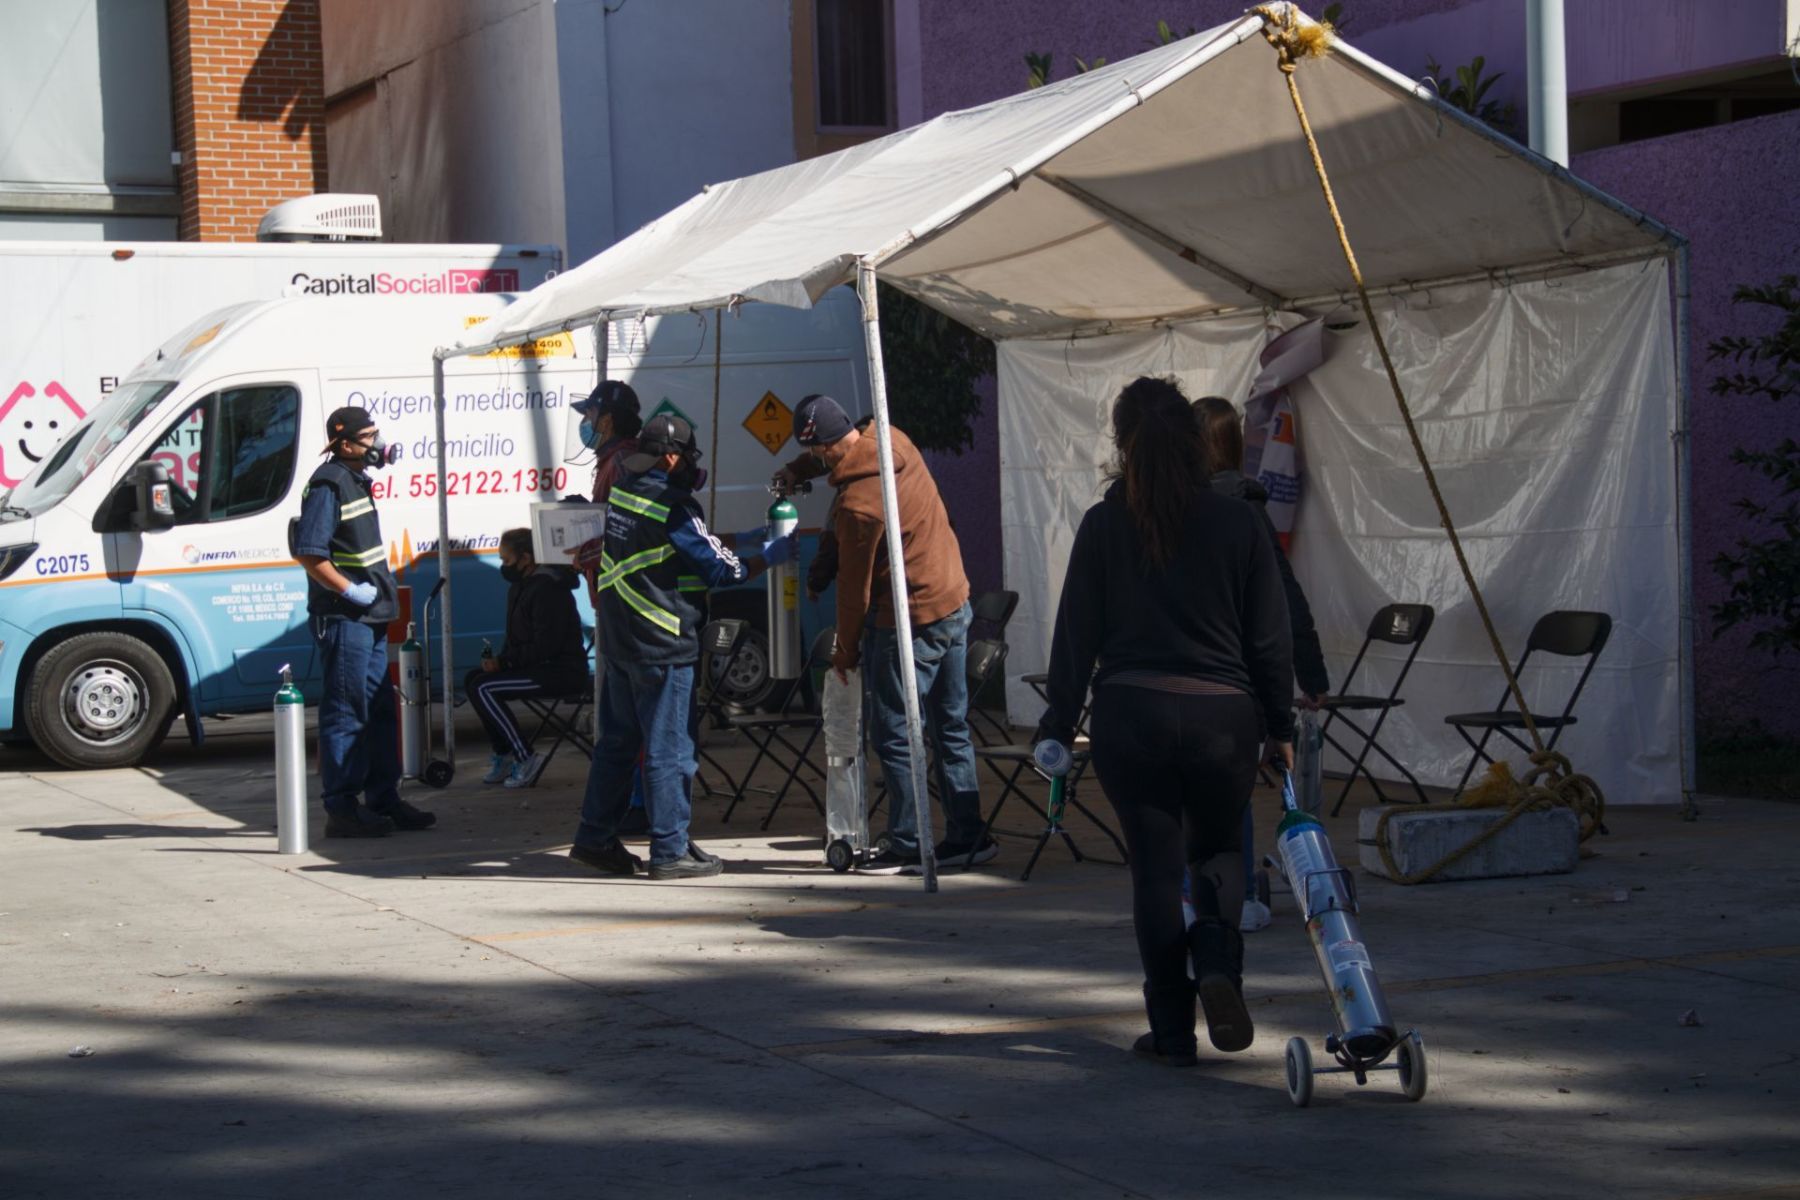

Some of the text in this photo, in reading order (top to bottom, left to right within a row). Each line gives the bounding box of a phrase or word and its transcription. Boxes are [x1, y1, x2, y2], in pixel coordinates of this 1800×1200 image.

[347, 386, 564, 420] Oxígen medicinal
[159, 429, 202, 446] N T
[413, 434, 514, 459] domicilio
[370, 467, 567, 499] el. 552122.1350
[417, 534, 500, 551] www.infra
[36, 554, 89, 575] C2075
